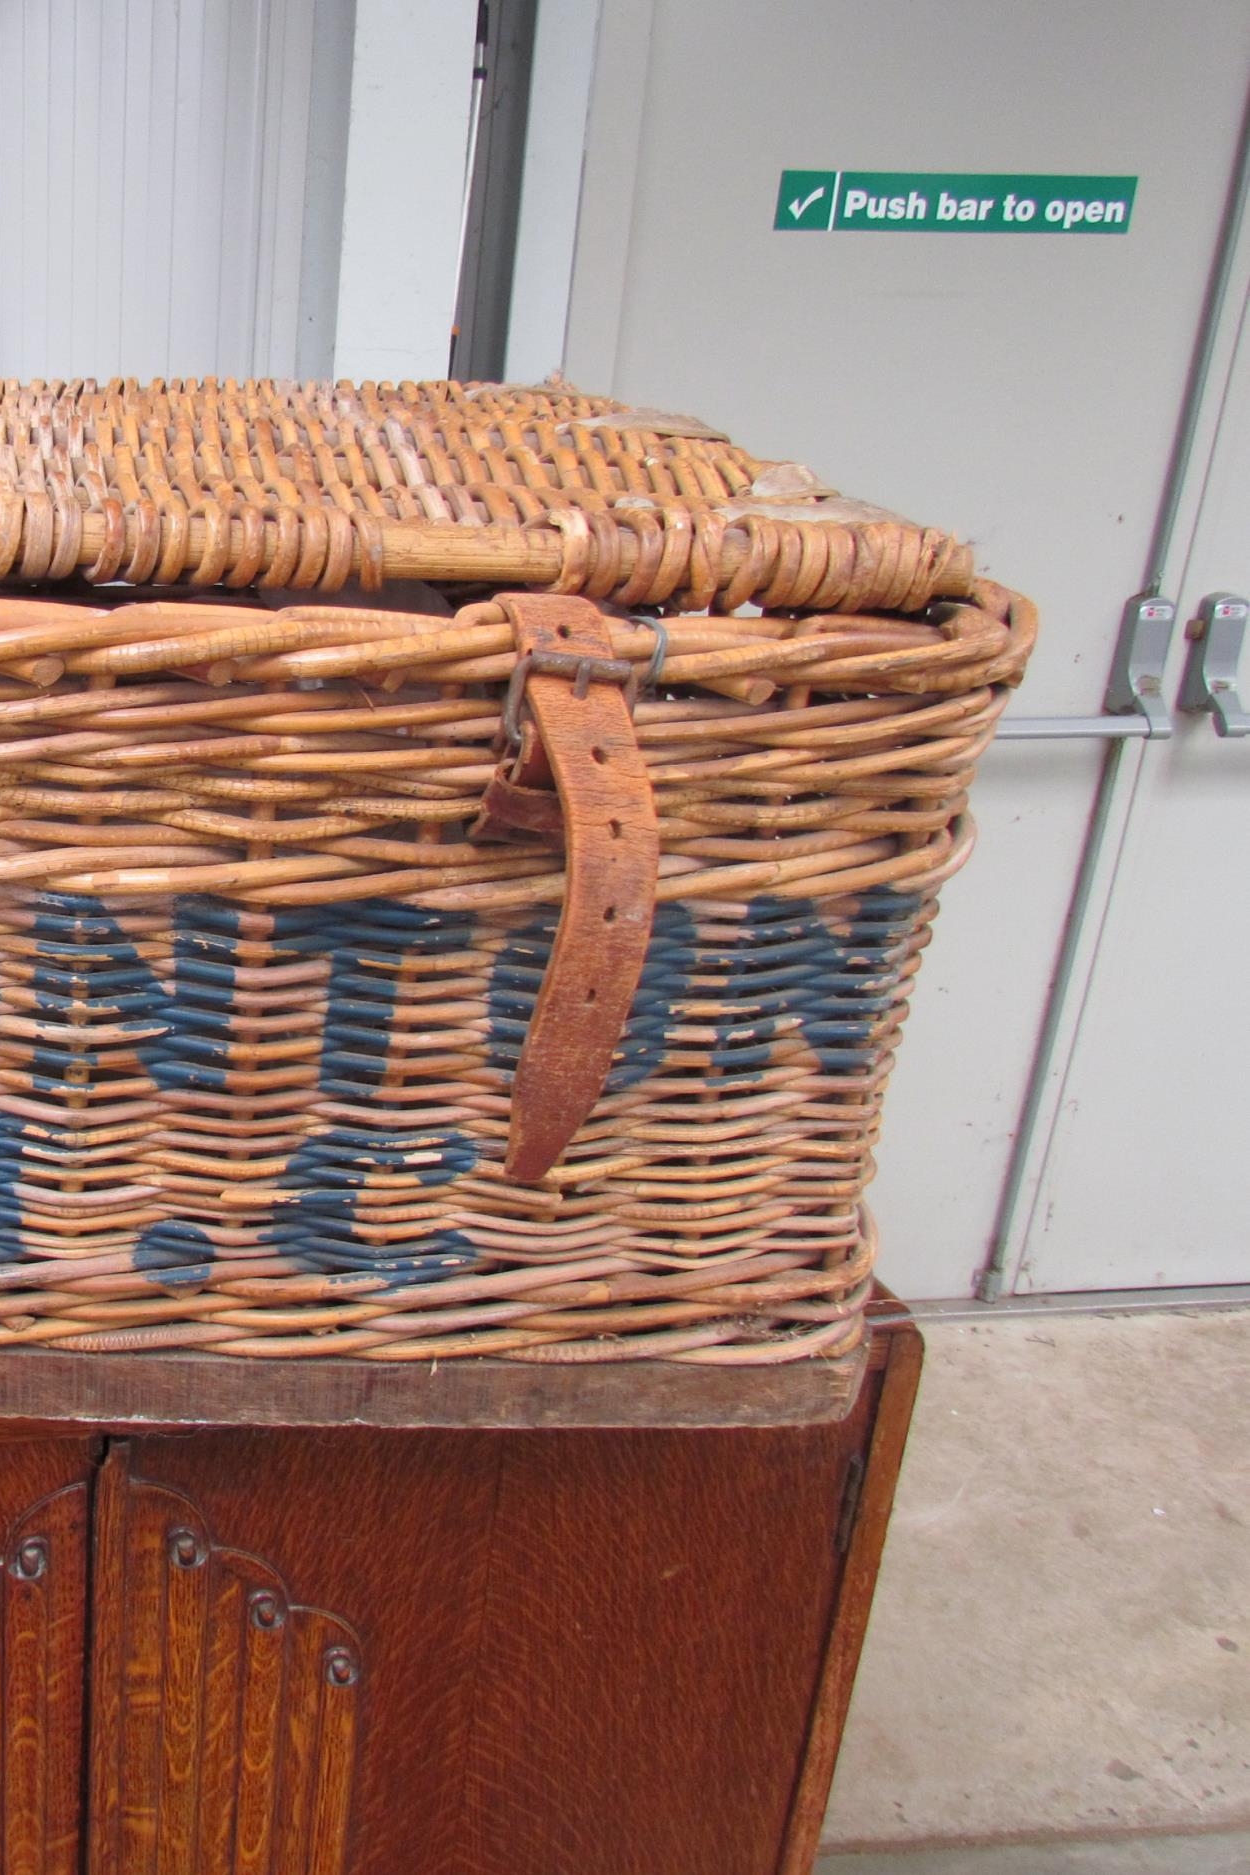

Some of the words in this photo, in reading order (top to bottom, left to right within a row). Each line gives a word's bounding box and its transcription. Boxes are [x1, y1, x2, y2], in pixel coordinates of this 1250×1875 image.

[843, 190, 927, 221] Push
[936, 193, 994, 222] bar
[1002, 194, 1035, 222] to
[1044, 199, 1125, 229] open
